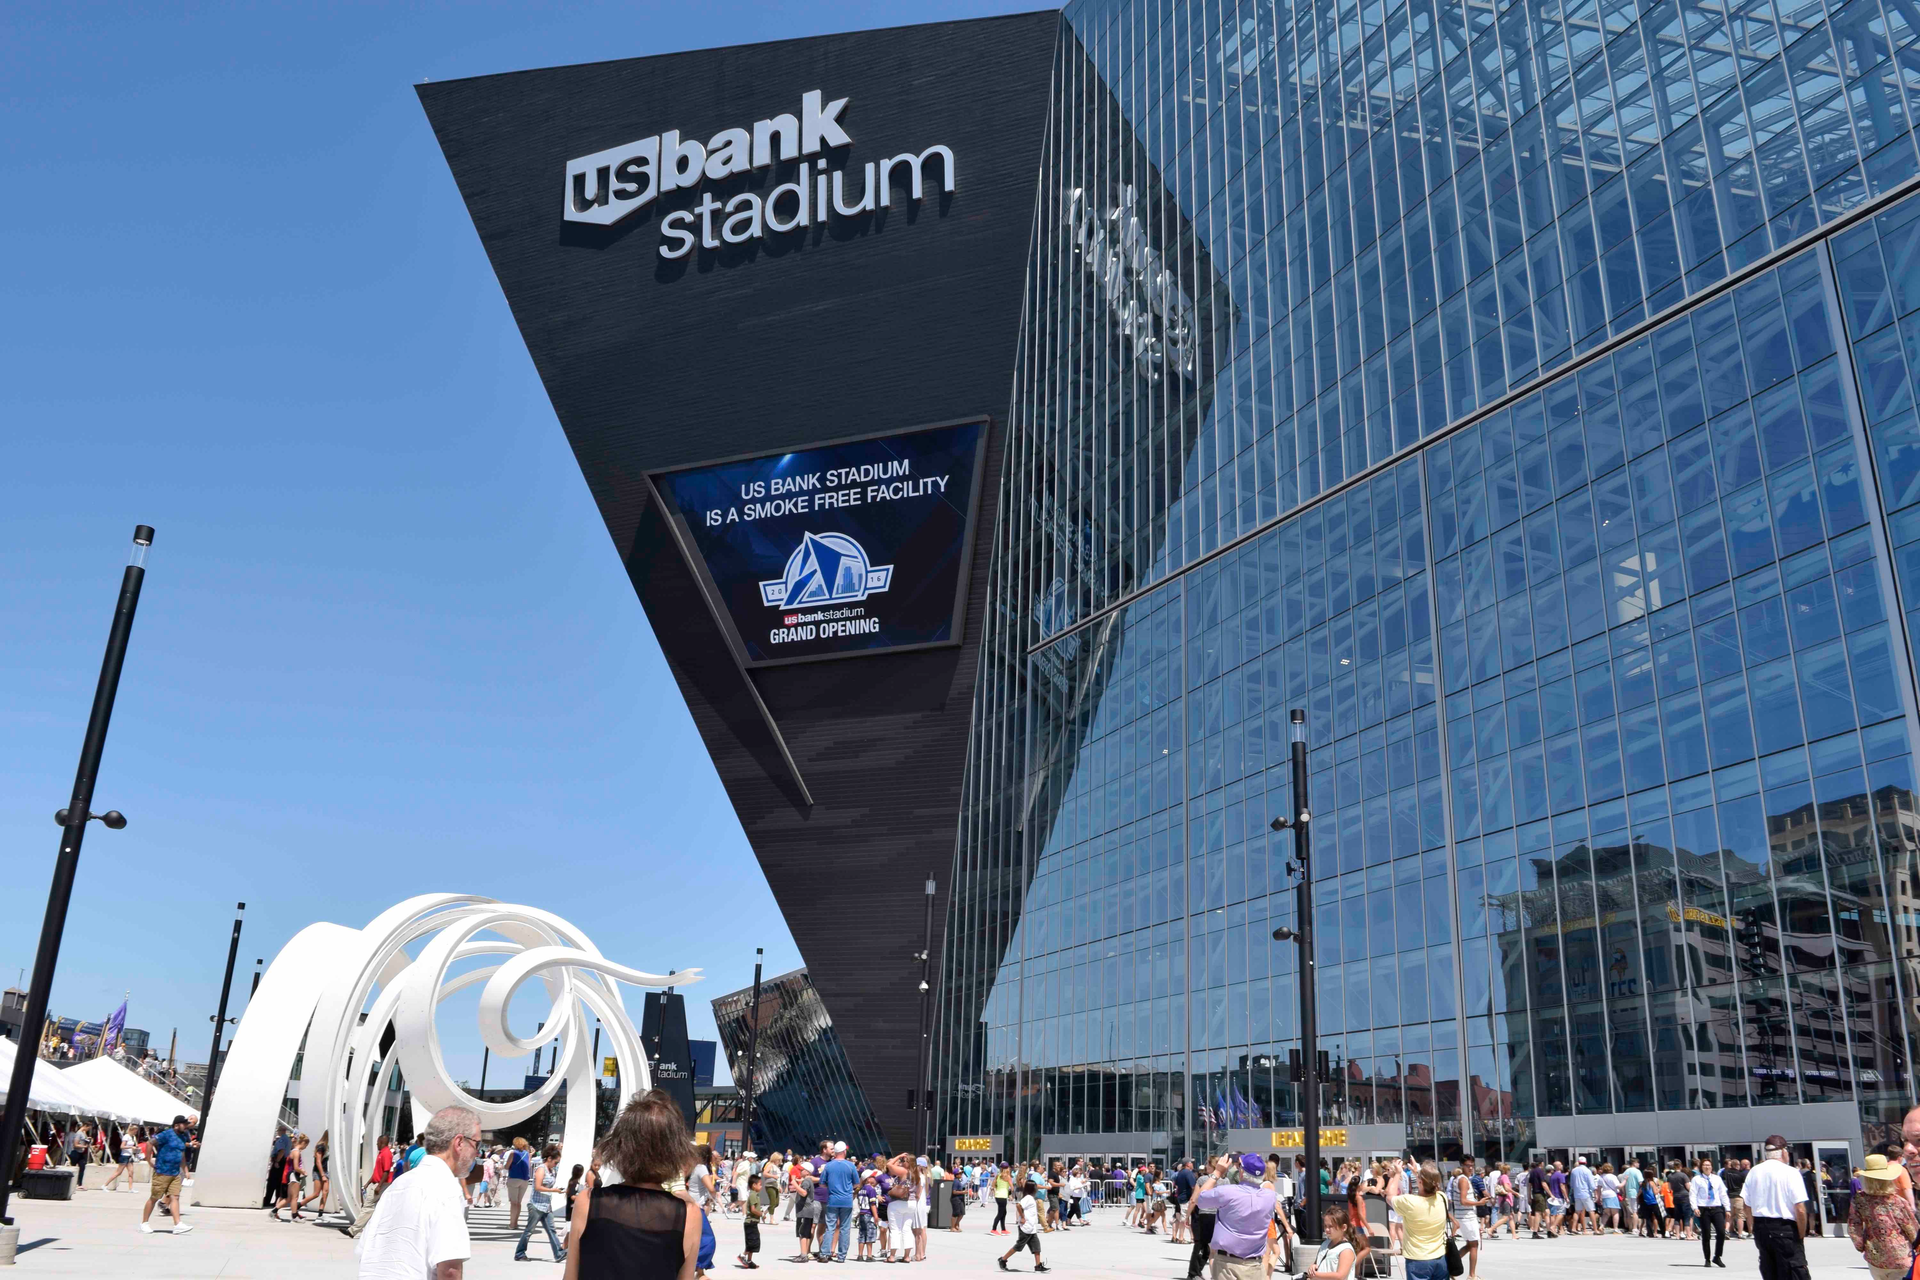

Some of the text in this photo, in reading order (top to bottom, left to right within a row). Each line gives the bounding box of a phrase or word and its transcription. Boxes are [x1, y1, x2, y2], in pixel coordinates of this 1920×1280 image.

[658, 144, 956, 260] stadium
[706, 474, 949, 526] IS A SMOKE FREE FACILITY
[741, 458, 910, 500] US BANK STADIUM
[770, 617, 880, 644] GRAND OPENING
[658, 1070, 688, 1079] tadium
